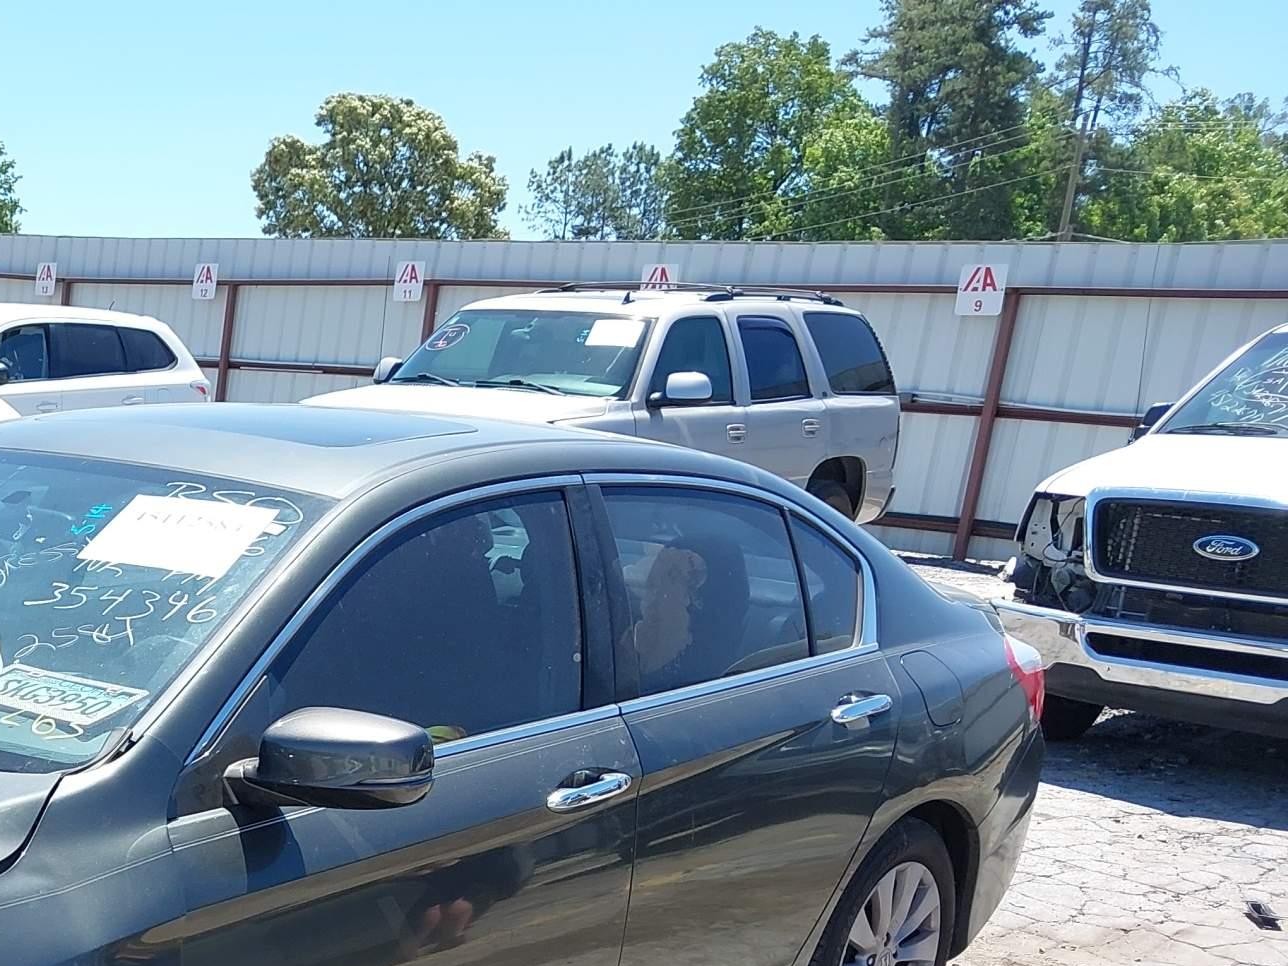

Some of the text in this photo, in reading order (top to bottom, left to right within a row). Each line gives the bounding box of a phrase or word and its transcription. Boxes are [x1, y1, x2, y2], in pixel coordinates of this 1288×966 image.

[200, 289, 208, 298] 12
[403, 290, 412, 299] 11
[974, 300, 983, 312] 9
[1206, 539, 1243, 557] Ford
